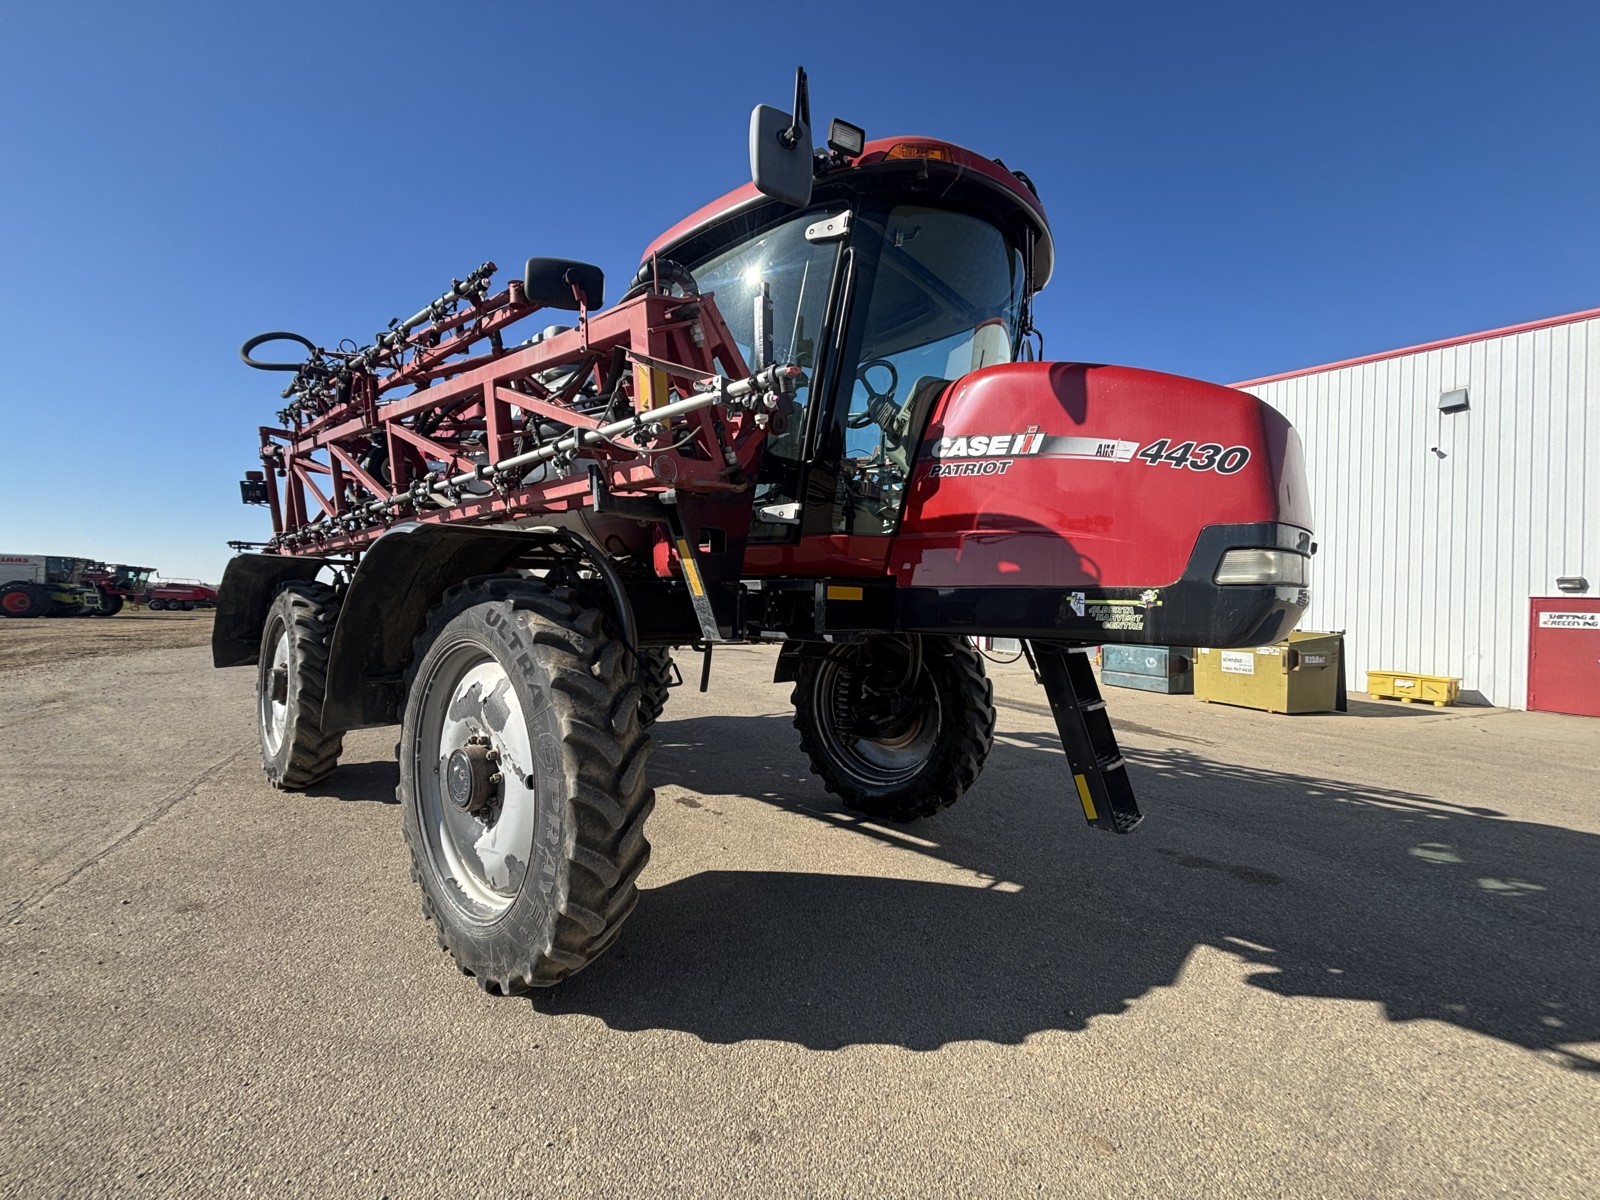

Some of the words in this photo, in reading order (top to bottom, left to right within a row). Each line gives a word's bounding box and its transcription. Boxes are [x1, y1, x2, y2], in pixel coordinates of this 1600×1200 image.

[931, 435, 1011, 458] CASE
[1137, 438, 1251, 475] 4430
[929, 460, 1013, 477] PATRIOT
[1089, 606, 1134, 616] ALBERTA
[1096, 614, 1143, 622] HARVEST
[1102, 622, 1143, 630] CENTRE
[485, 608, 546, 711] ULTRA
